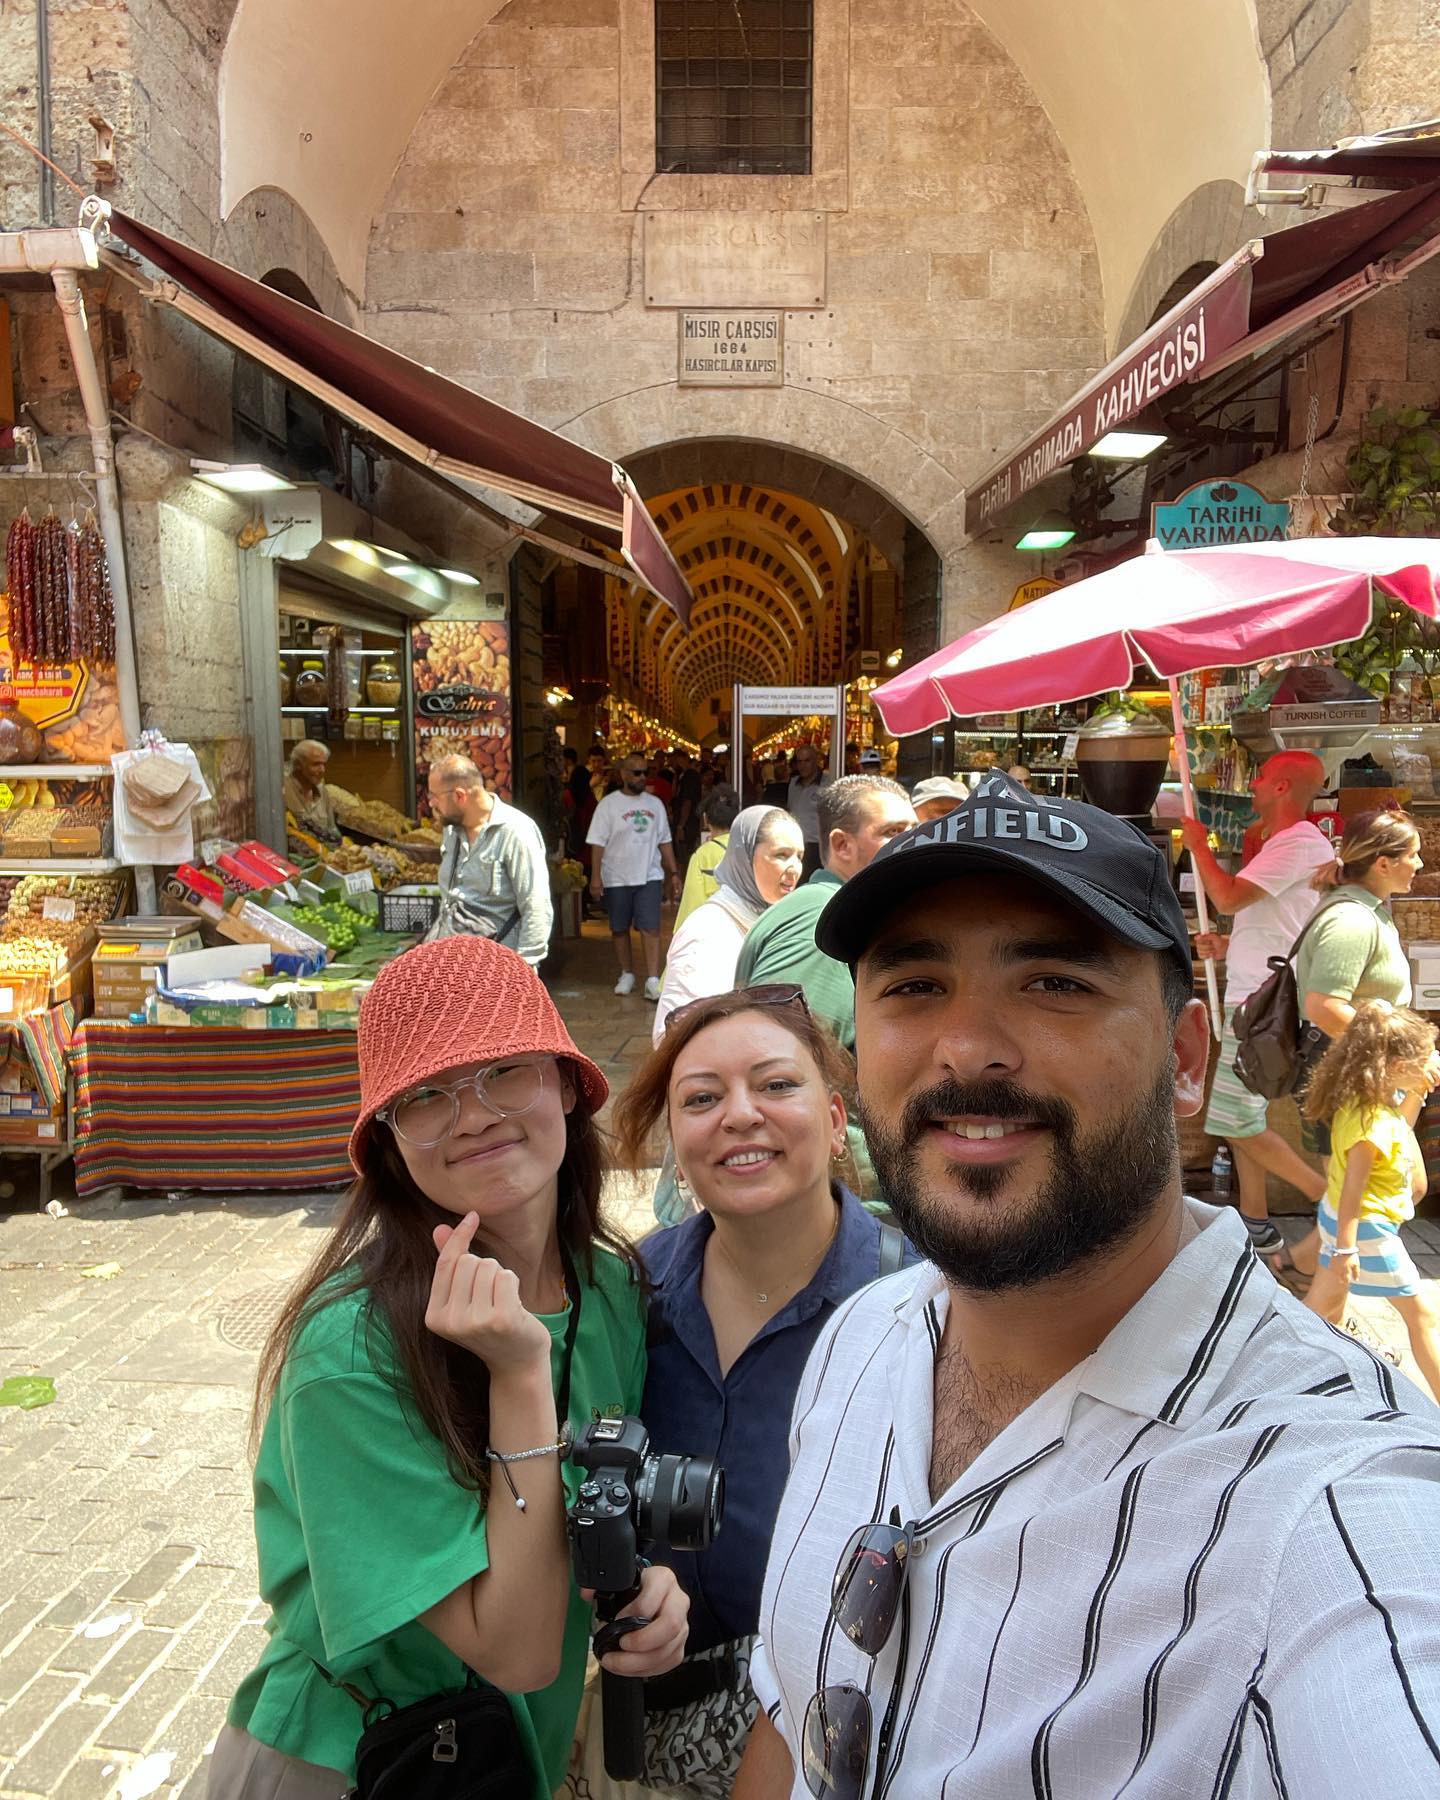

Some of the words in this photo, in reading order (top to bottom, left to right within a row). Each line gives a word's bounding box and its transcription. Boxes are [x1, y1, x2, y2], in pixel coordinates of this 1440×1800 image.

[685, 320, 720, 338] MISIR
[713, 342, 747, 354] 1664
[685, 358, 744, 371] HASIRCILAR
[745, 359, 777, 372] KAPISI
[1018, 414, 1083, 492] YARIMADA
[1094, 306, 1206, 436] KAHVECİSİ
[1160, 525, 1285, 544] YARIMADA
[427, 696, 496, 711] Sahra
[1284, 711, 1326, 720] TURKISH
[1328, 709, 1367, 719] COFFEE
[420, 724, 506, 738] KURUYEMİŞ
